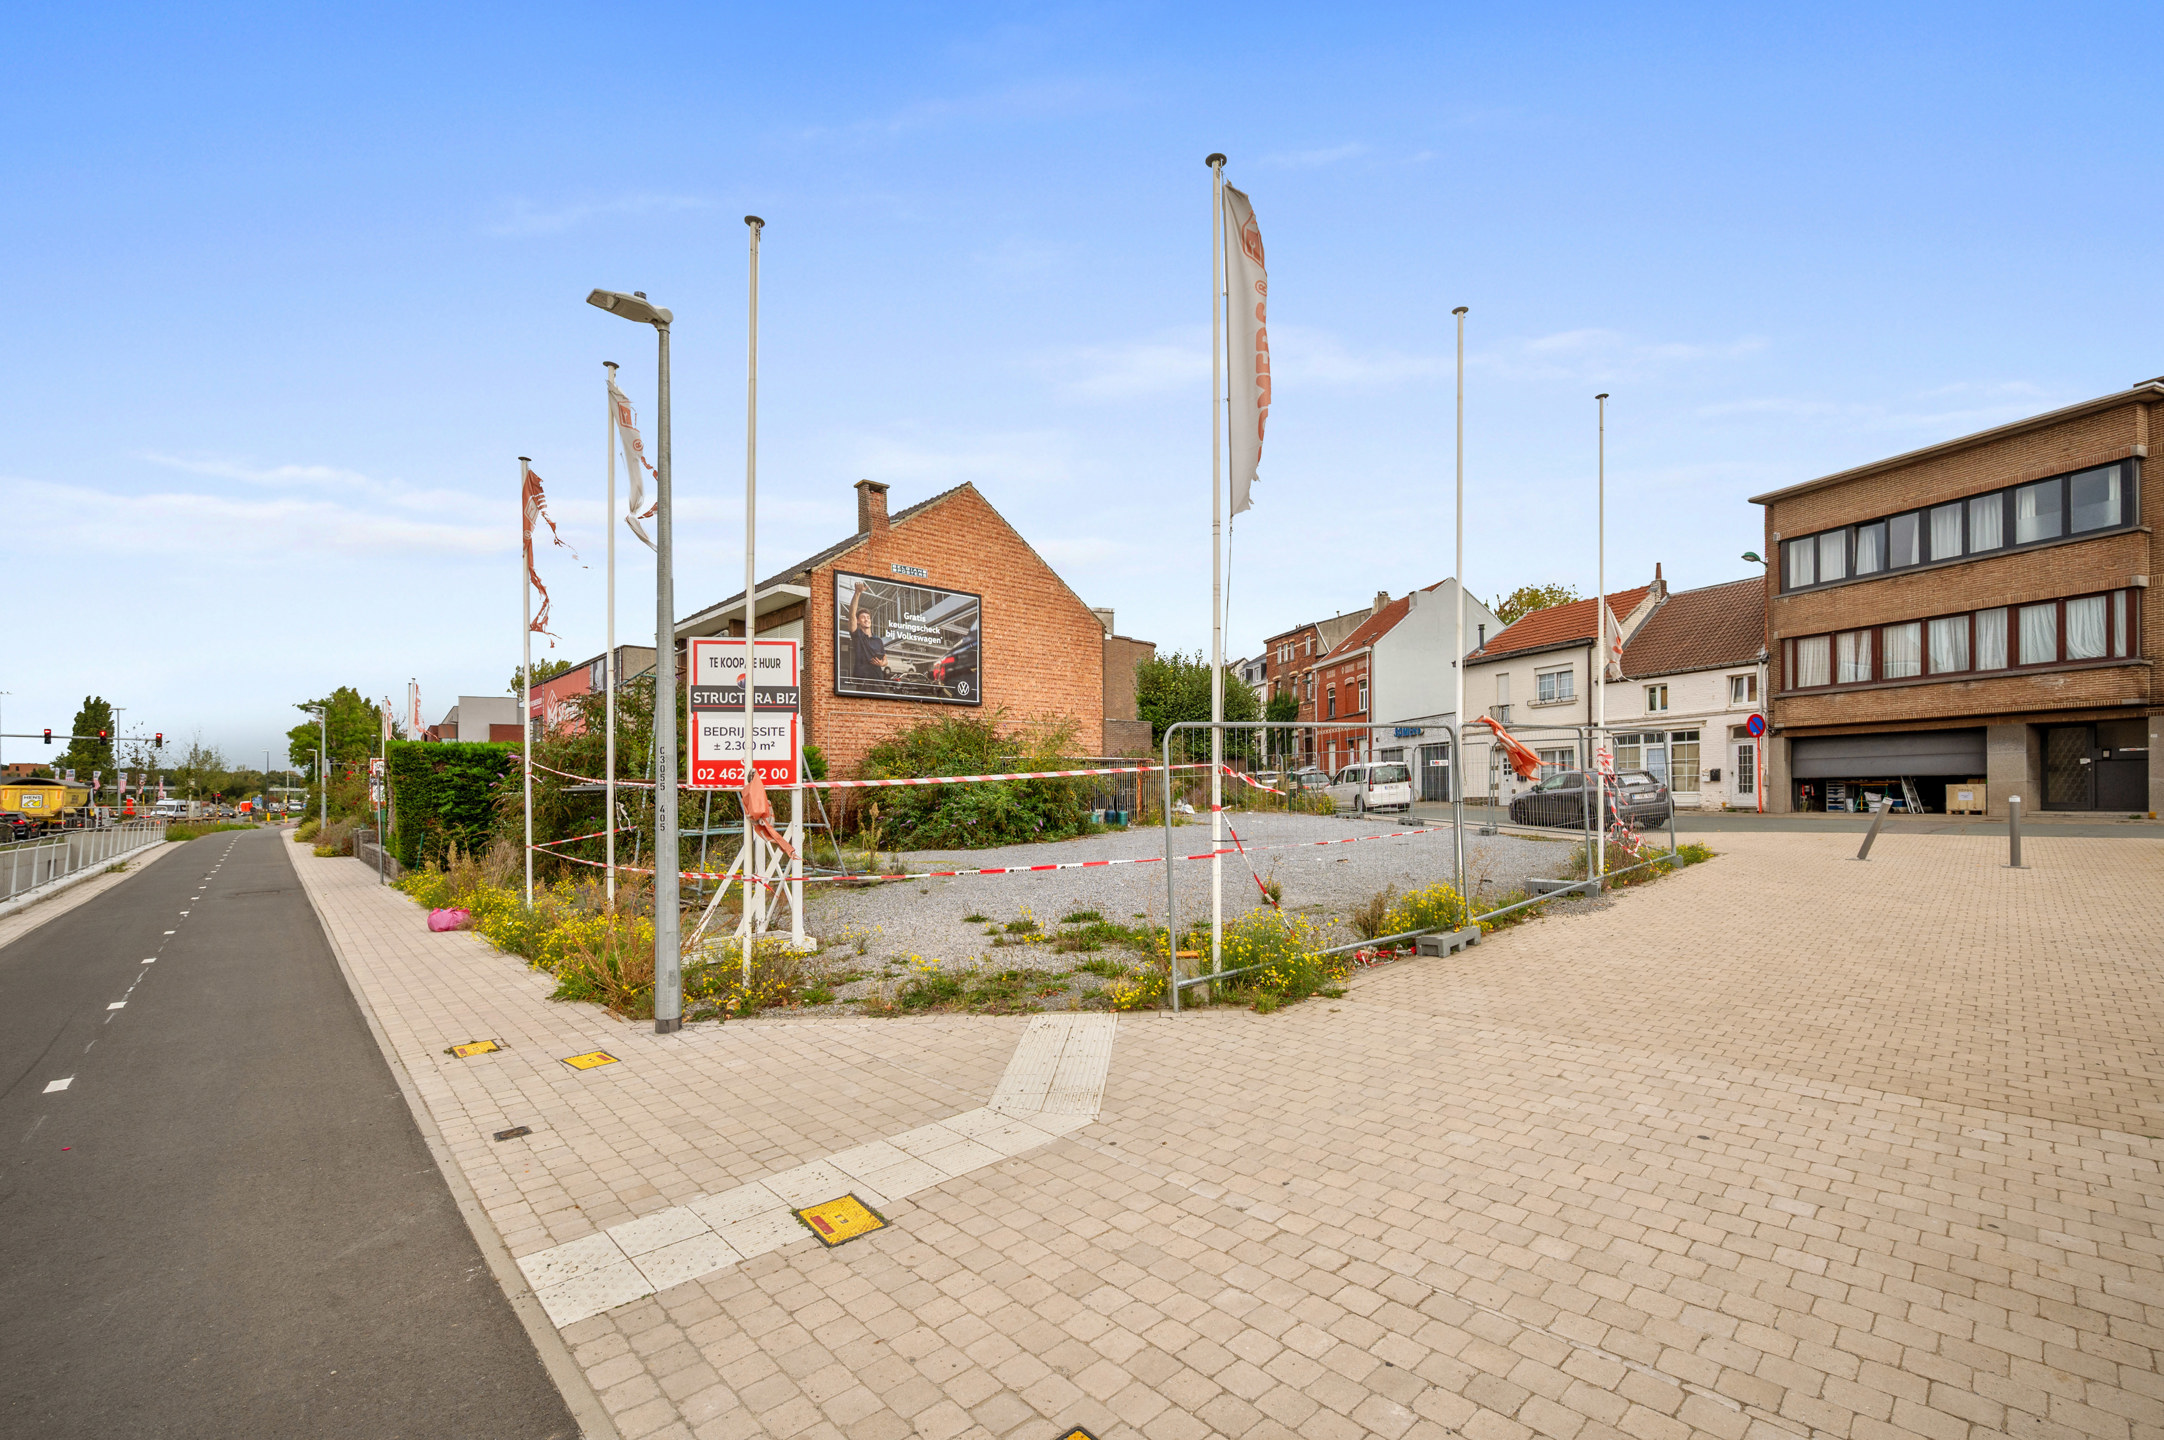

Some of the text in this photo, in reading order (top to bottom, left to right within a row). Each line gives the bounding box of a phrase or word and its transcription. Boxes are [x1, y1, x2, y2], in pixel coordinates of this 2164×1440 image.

[903, 612, 926, 622] Gratis
[888, 619, 941, 635] keuringscheck
[885, 629, 896, 641] bij
[709, 657, 718, 668] TE
[759, 658, 781, 669] HUUR
[693, 691, 797, 705] STRUCTRA.BIZ
[703, 726, 786, 739] BEDRIJSSITE
[760, 741, 775, 751] m²
[697, 768, 715, 780] 02
[719, 768, 745, 780] 462
[770, 767, 789, 780] 00
